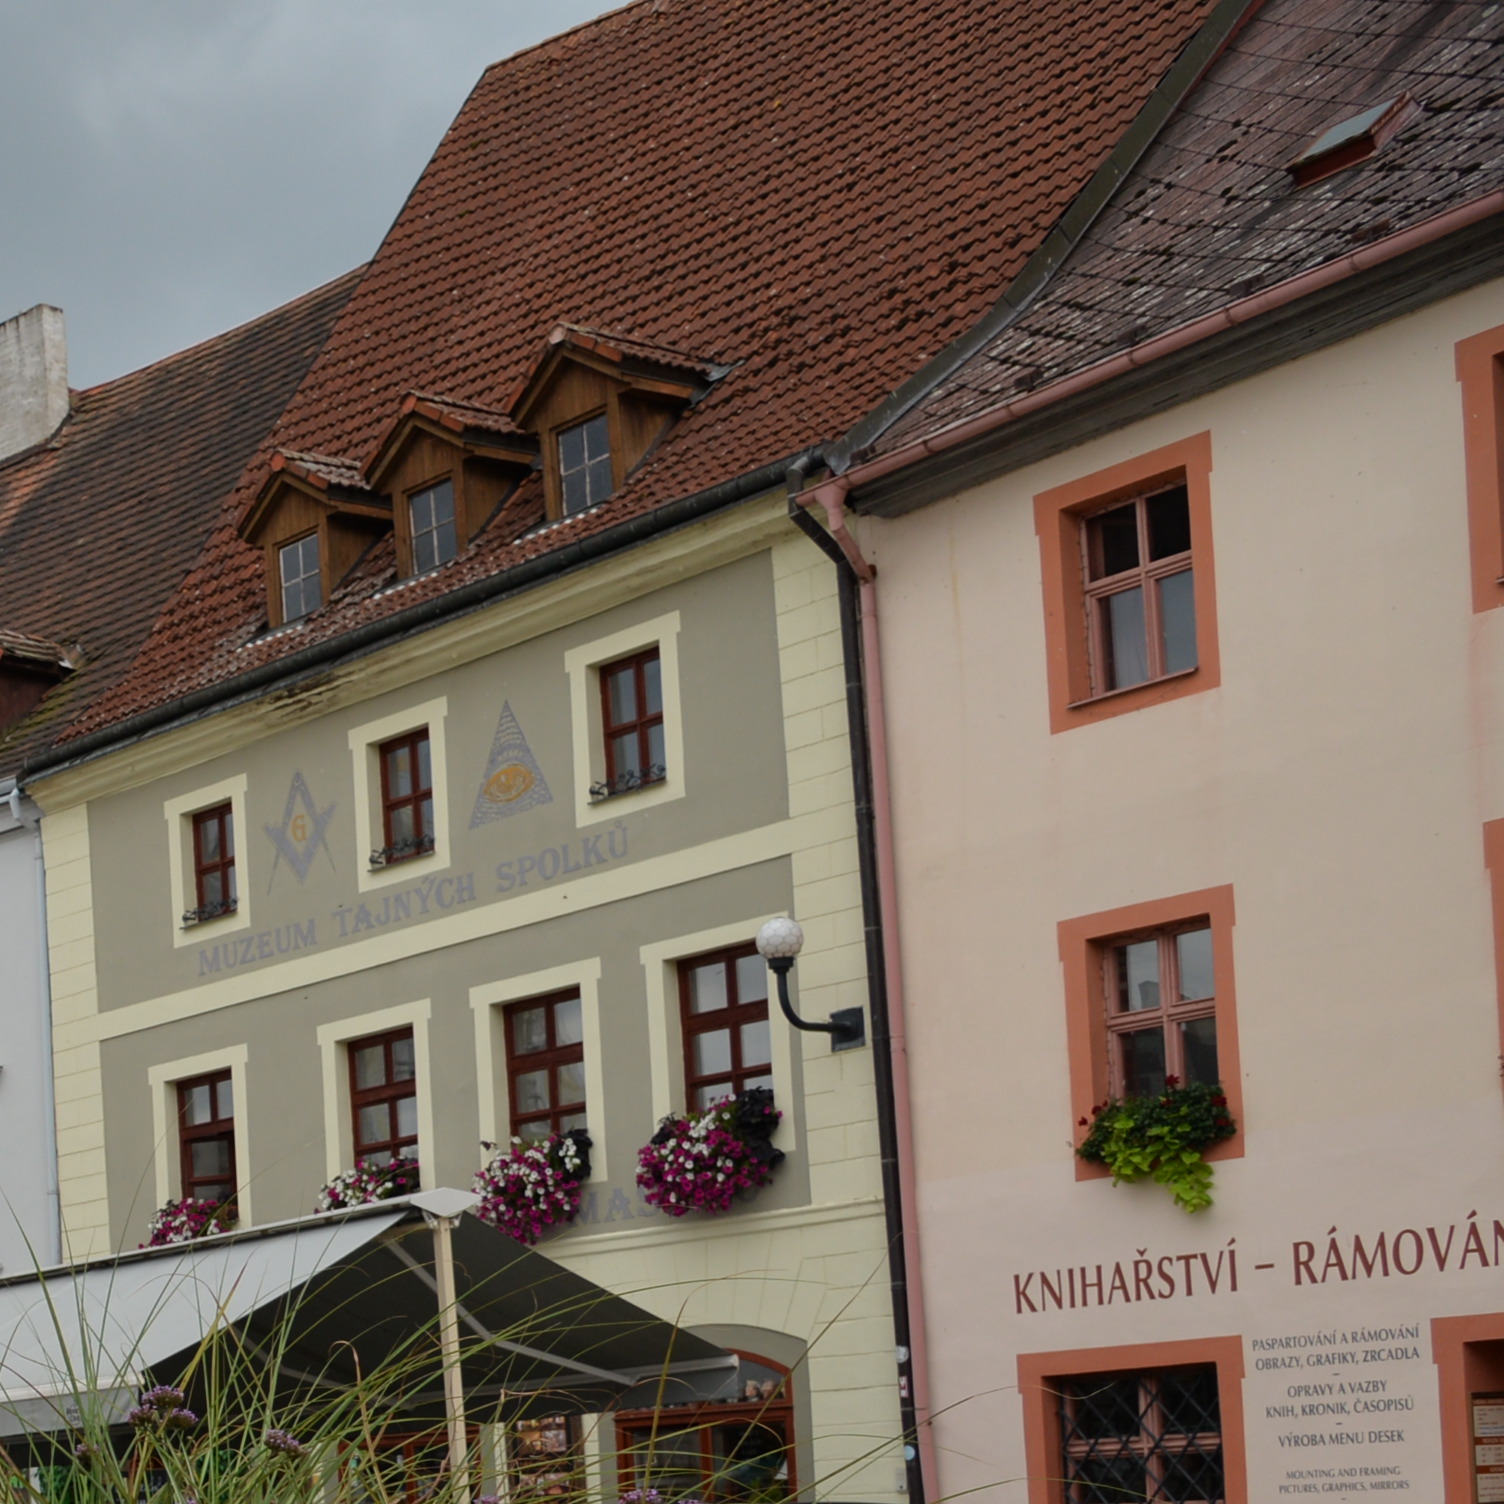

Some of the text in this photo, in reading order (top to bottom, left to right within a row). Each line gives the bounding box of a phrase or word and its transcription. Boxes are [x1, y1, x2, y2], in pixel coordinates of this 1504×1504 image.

[198, 819, 629, 976] MUZEUM TAJNÝCH SPOLKŮ
[1011, 1236, 1239, 1315] KNIHAŘSTVÍ
[1252, 1323, 1420, 1351] PASPARTOVÁNÍ A RÁMOVÁNÍ
[1255, 1347, 1420, 1371] OBRAZY, GRAFIKY, ZRCADLA
[1287, 1380, 1388, 1398] OPRAVY A VAZBY
[1266, 1395, 1414, 1419] KNIH, KRONIK, ČASOPISŮ
[1278, 1430, 1405, 1448] VÝROBA MENU DESEK
[1286, 1466, 1401, 1479] MOUNTING AND FRAMING
[1279, 1480, 1410, 1494] PICTURES, GRAPHICS, MIRRORS
